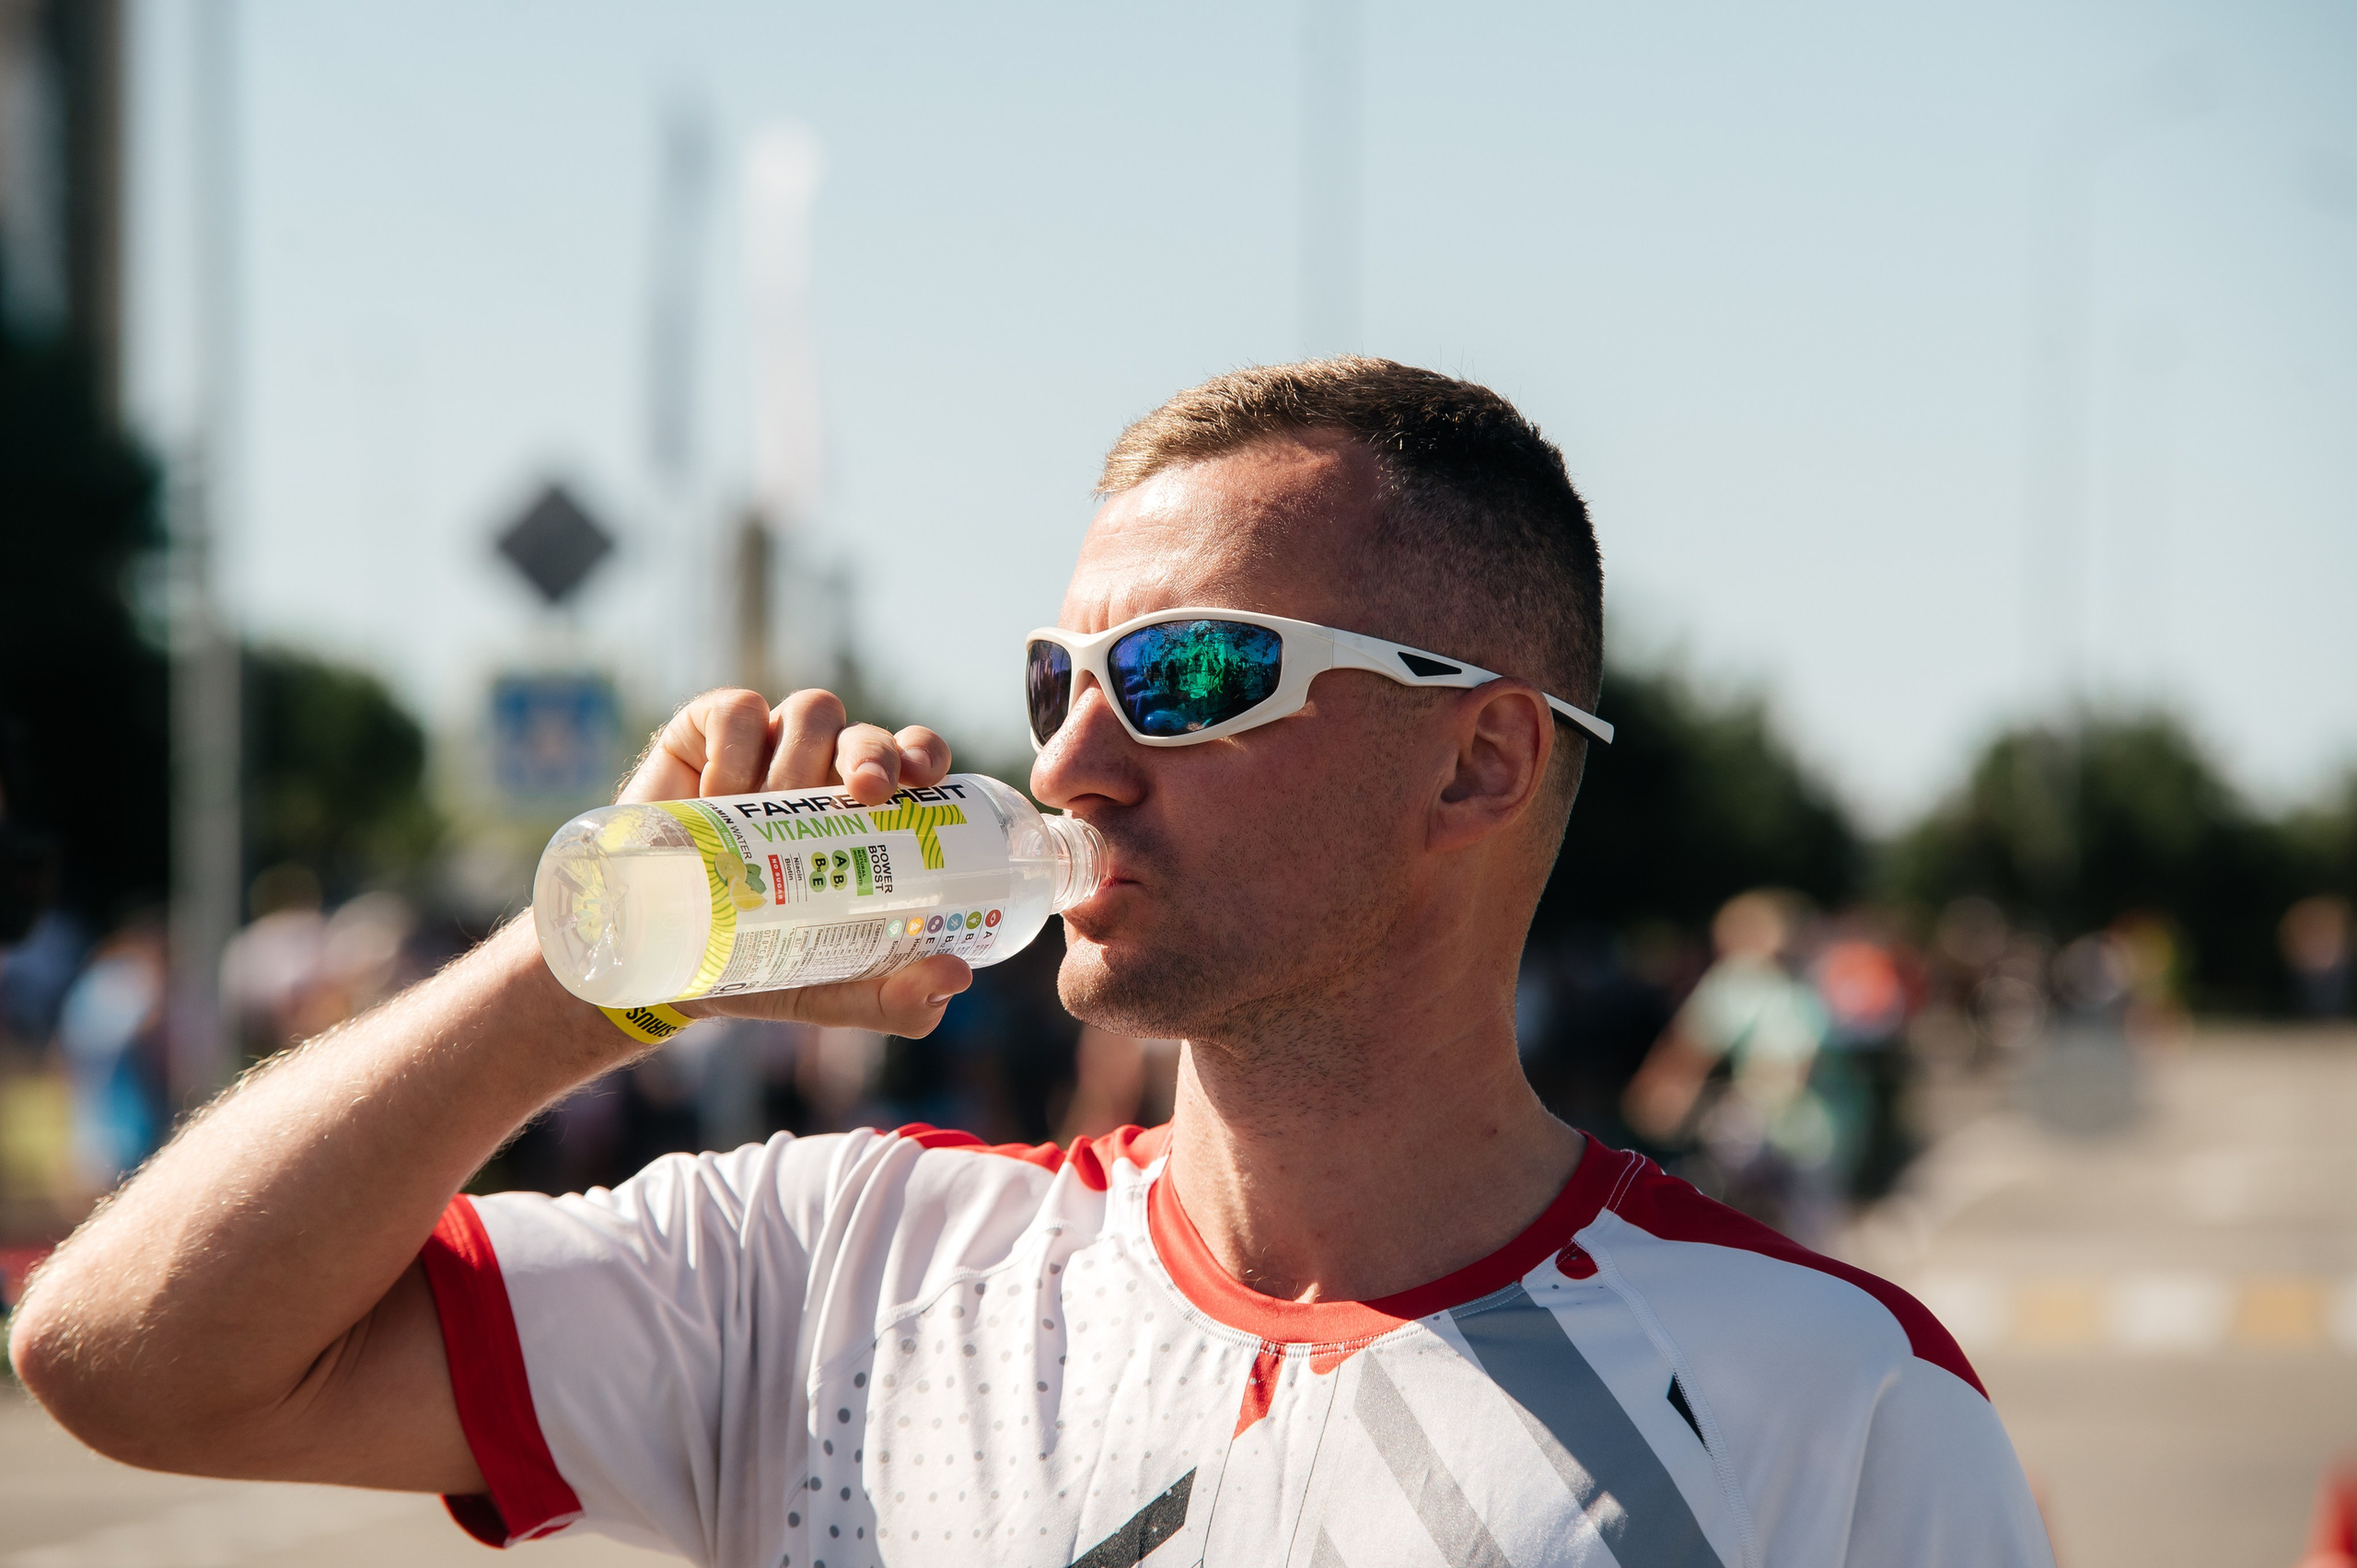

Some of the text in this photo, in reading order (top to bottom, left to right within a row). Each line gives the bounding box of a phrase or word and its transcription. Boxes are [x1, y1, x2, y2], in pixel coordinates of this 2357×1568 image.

[733, 784, 967, 819] FAHREHEIT
[698, 800, 752, 859] VITAMIN WATER
[722, 831, 735, 848] Mint
[751, 813, 868, 842] VITAMIN
[784, 858, 794, 880] Biotin
[794, 857, 802, 881] Niacin
[835, 854, 847, 867] A
[856, 849, 865, 877] NATURAL
[868, 845, 885, 891] BOOST
[877, 844, 893, 894] POWER
[771, 858, 784, 900] NO SUGAR
[812, 877, 824, 887] E
[626, 1007, 677, 1038] SIRIUS
